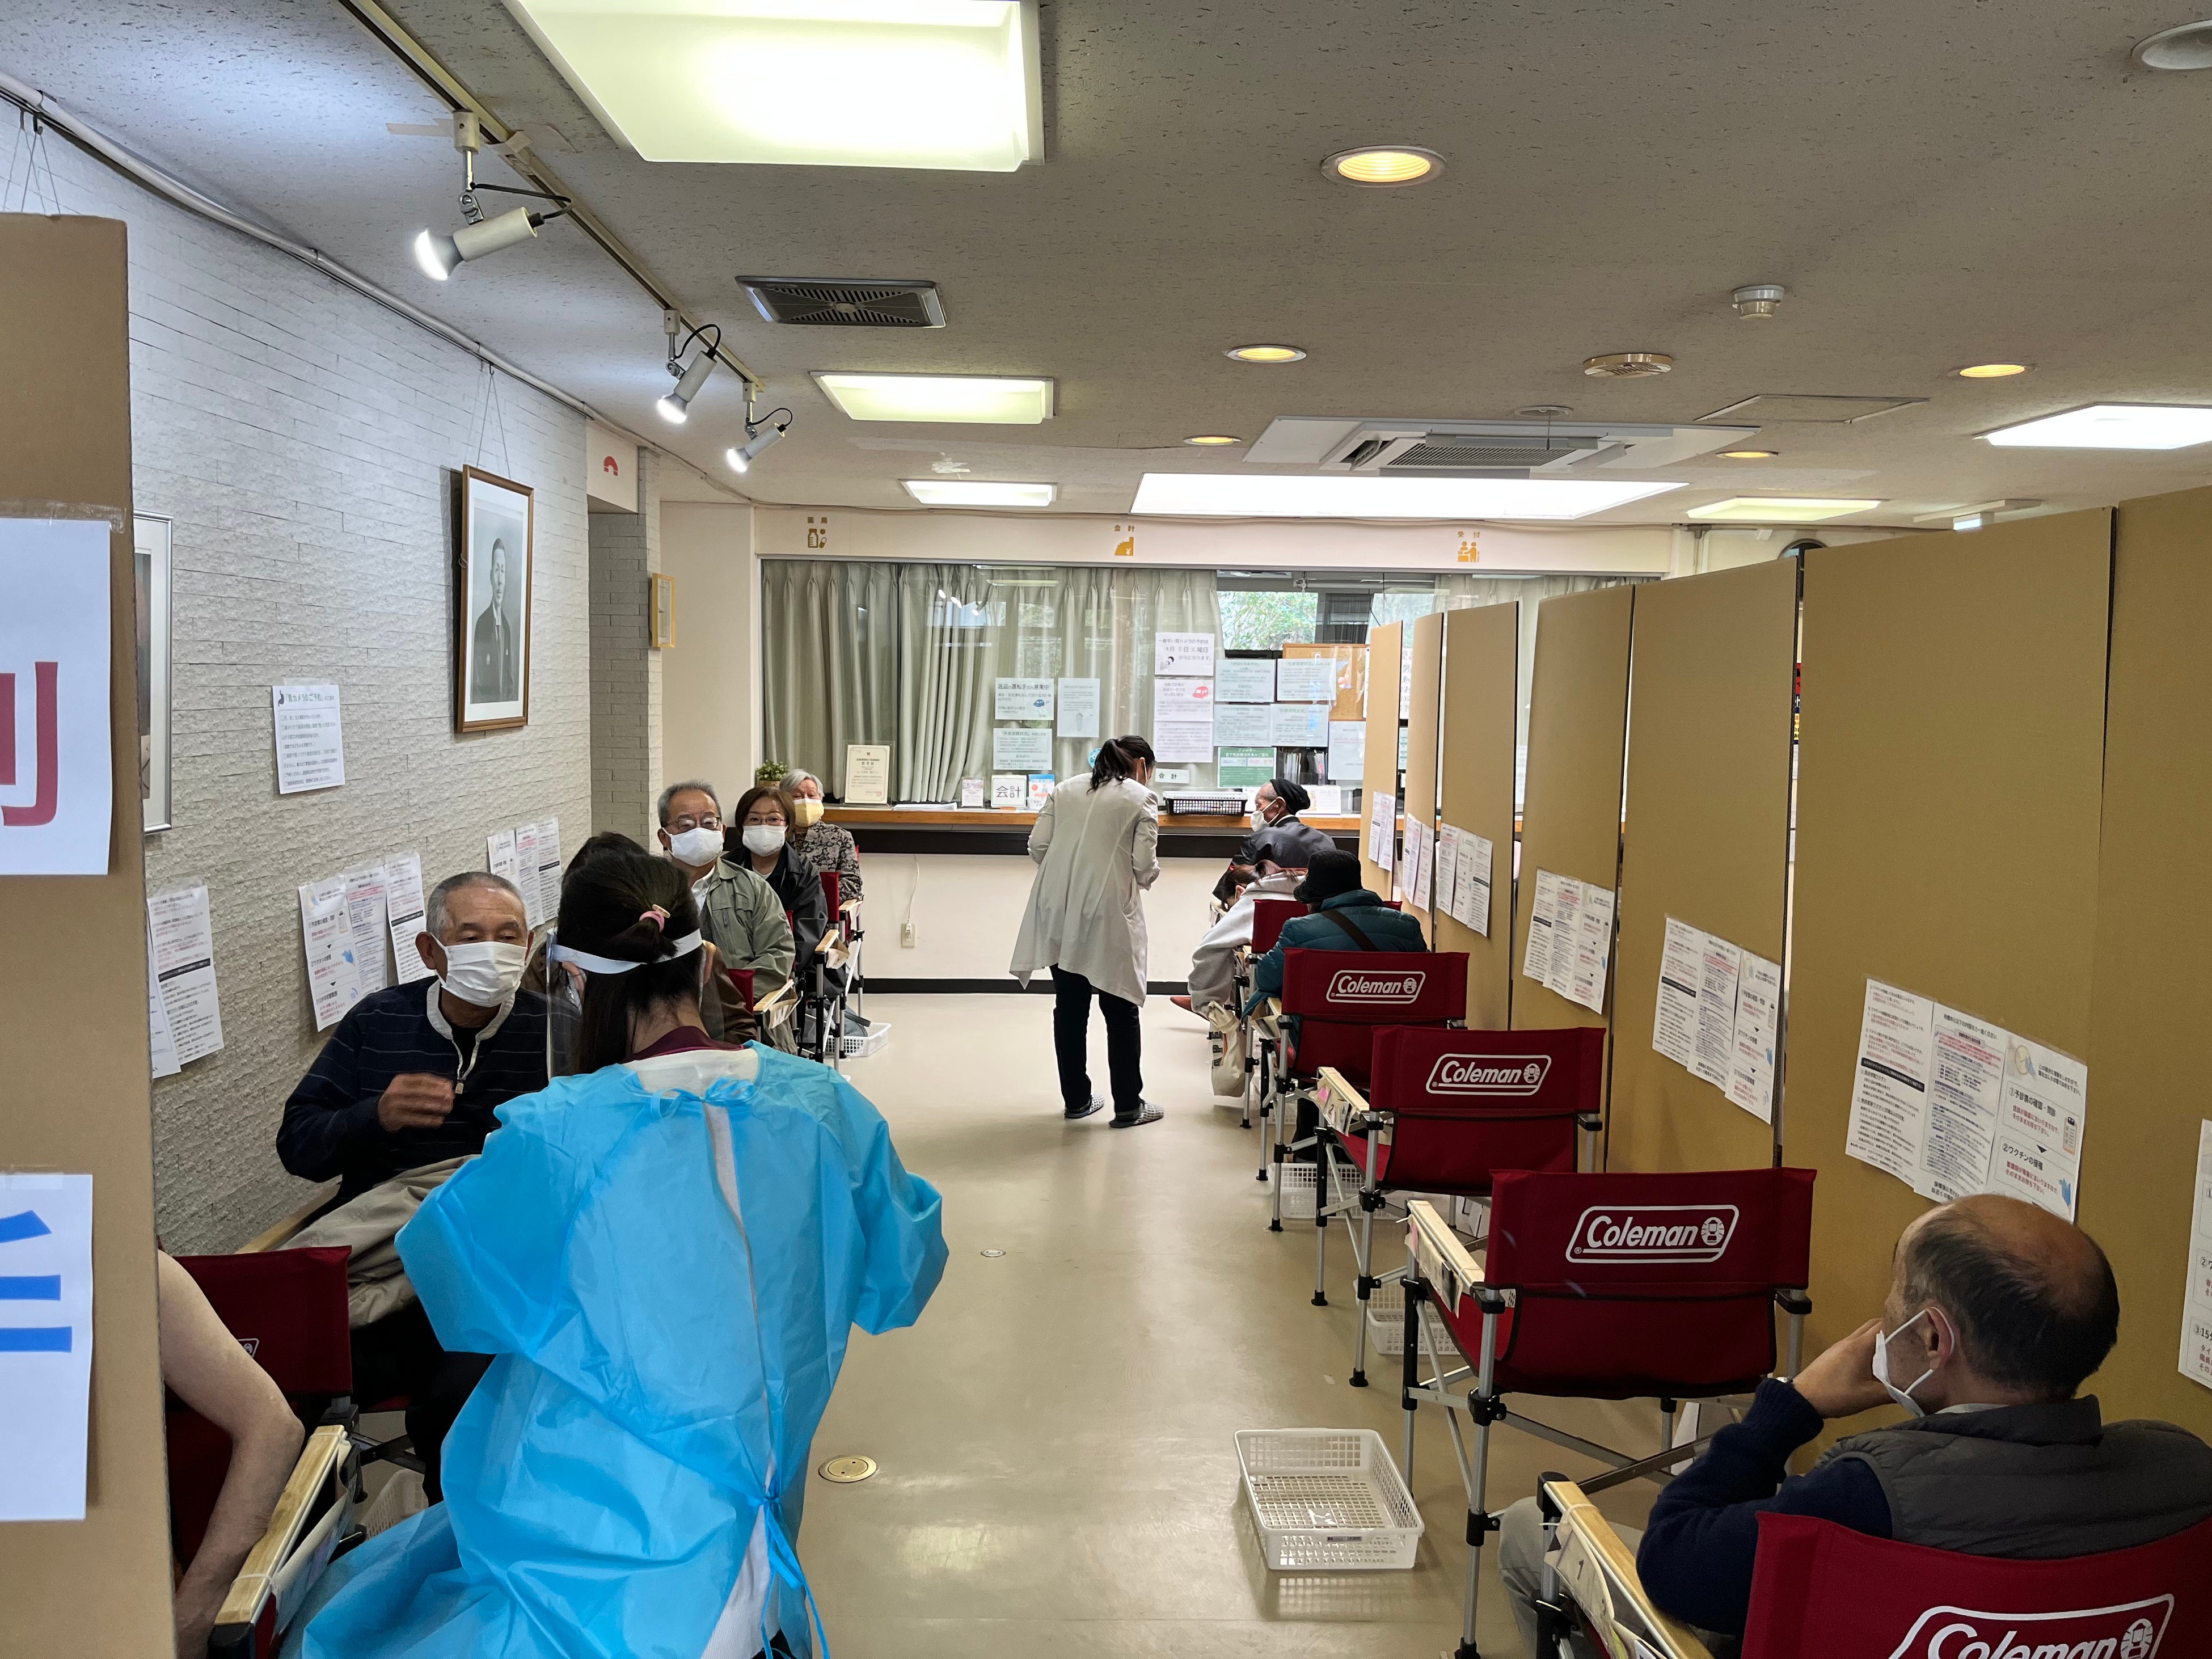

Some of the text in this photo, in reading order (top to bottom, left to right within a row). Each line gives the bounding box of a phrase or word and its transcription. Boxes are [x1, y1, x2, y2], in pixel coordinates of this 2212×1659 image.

[996, 786, 1021, 798] 会計
[1337, 975, 1402, 994] Coleman
[1441, 1060, 1522, 1083] Coleman
[1587, 1215, 1699, 1248] Coleman
